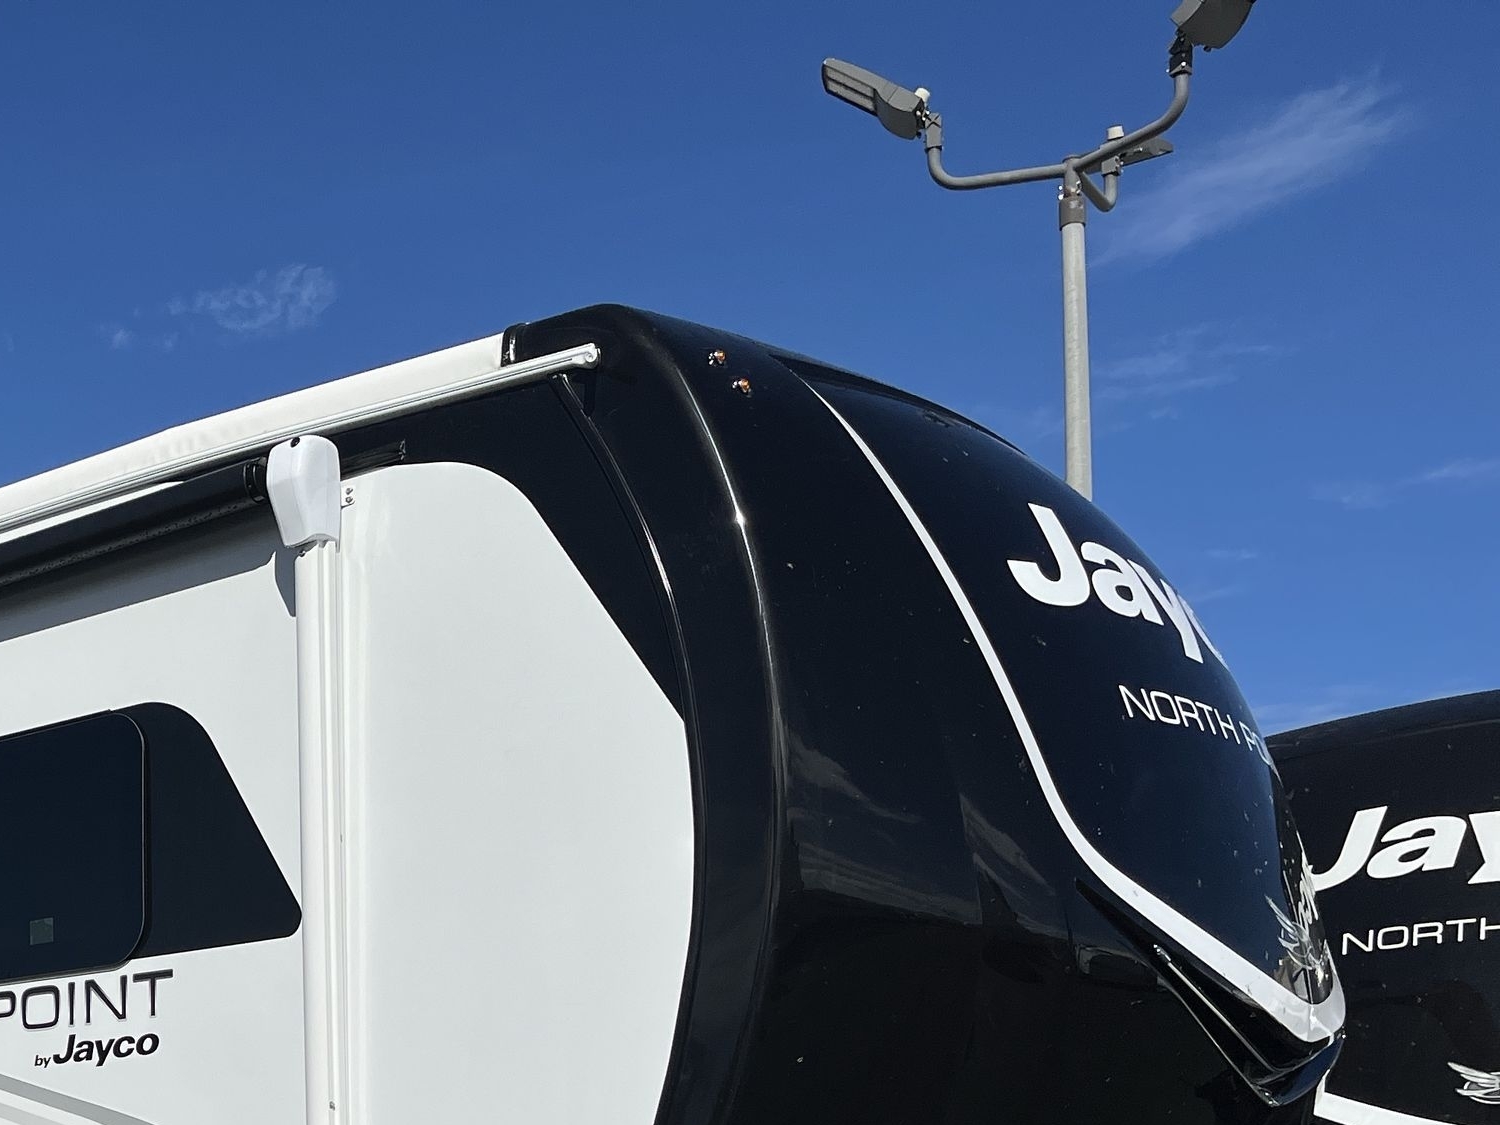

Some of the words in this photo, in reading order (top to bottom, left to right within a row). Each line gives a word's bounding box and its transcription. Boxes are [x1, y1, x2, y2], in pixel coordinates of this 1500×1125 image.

[1118, 684, 1241, 745] NORTH
[34, 1055, 52, 1069] by
[52, 1032, 160, 1068] Jayco
